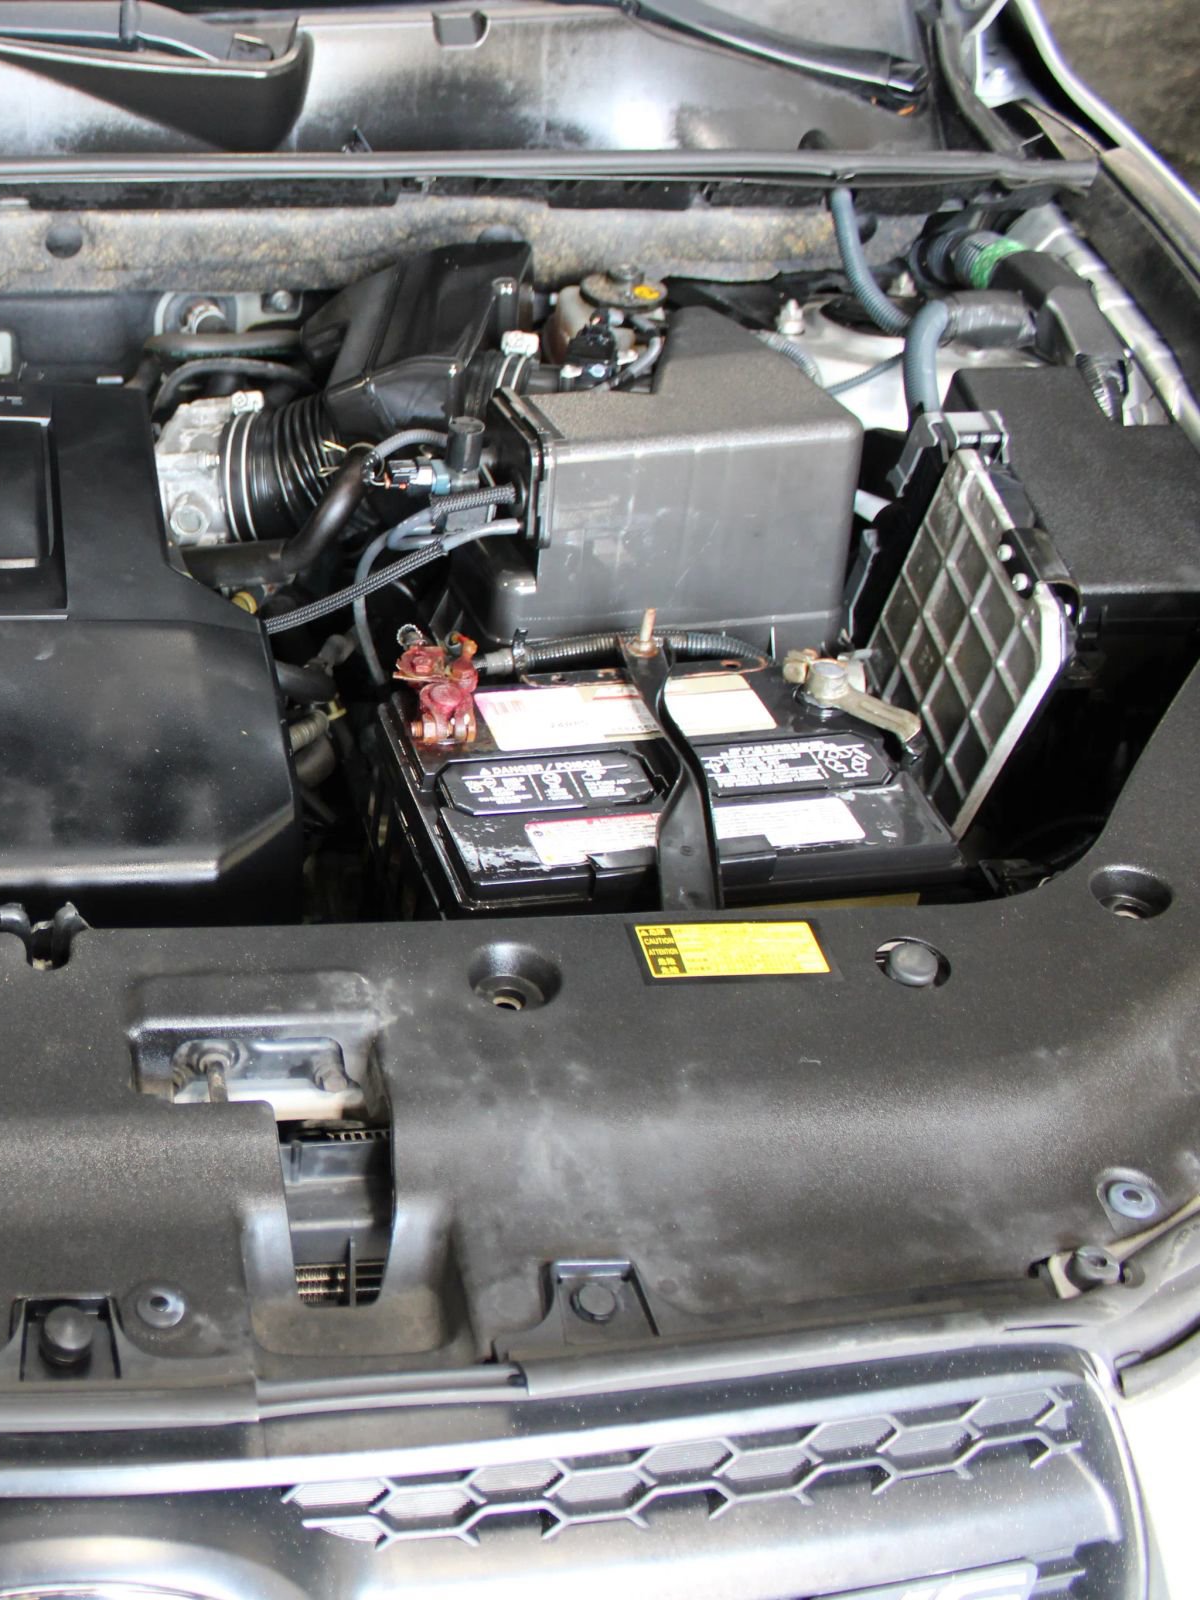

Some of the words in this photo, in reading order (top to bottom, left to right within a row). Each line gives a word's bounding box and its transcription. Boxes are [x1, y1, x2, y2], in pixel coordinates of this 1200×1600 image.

[491, 763, 544, 775] DANGER
[555, 760, 601, 771] POISON
[644, 937, 675, 945] CAUTION
